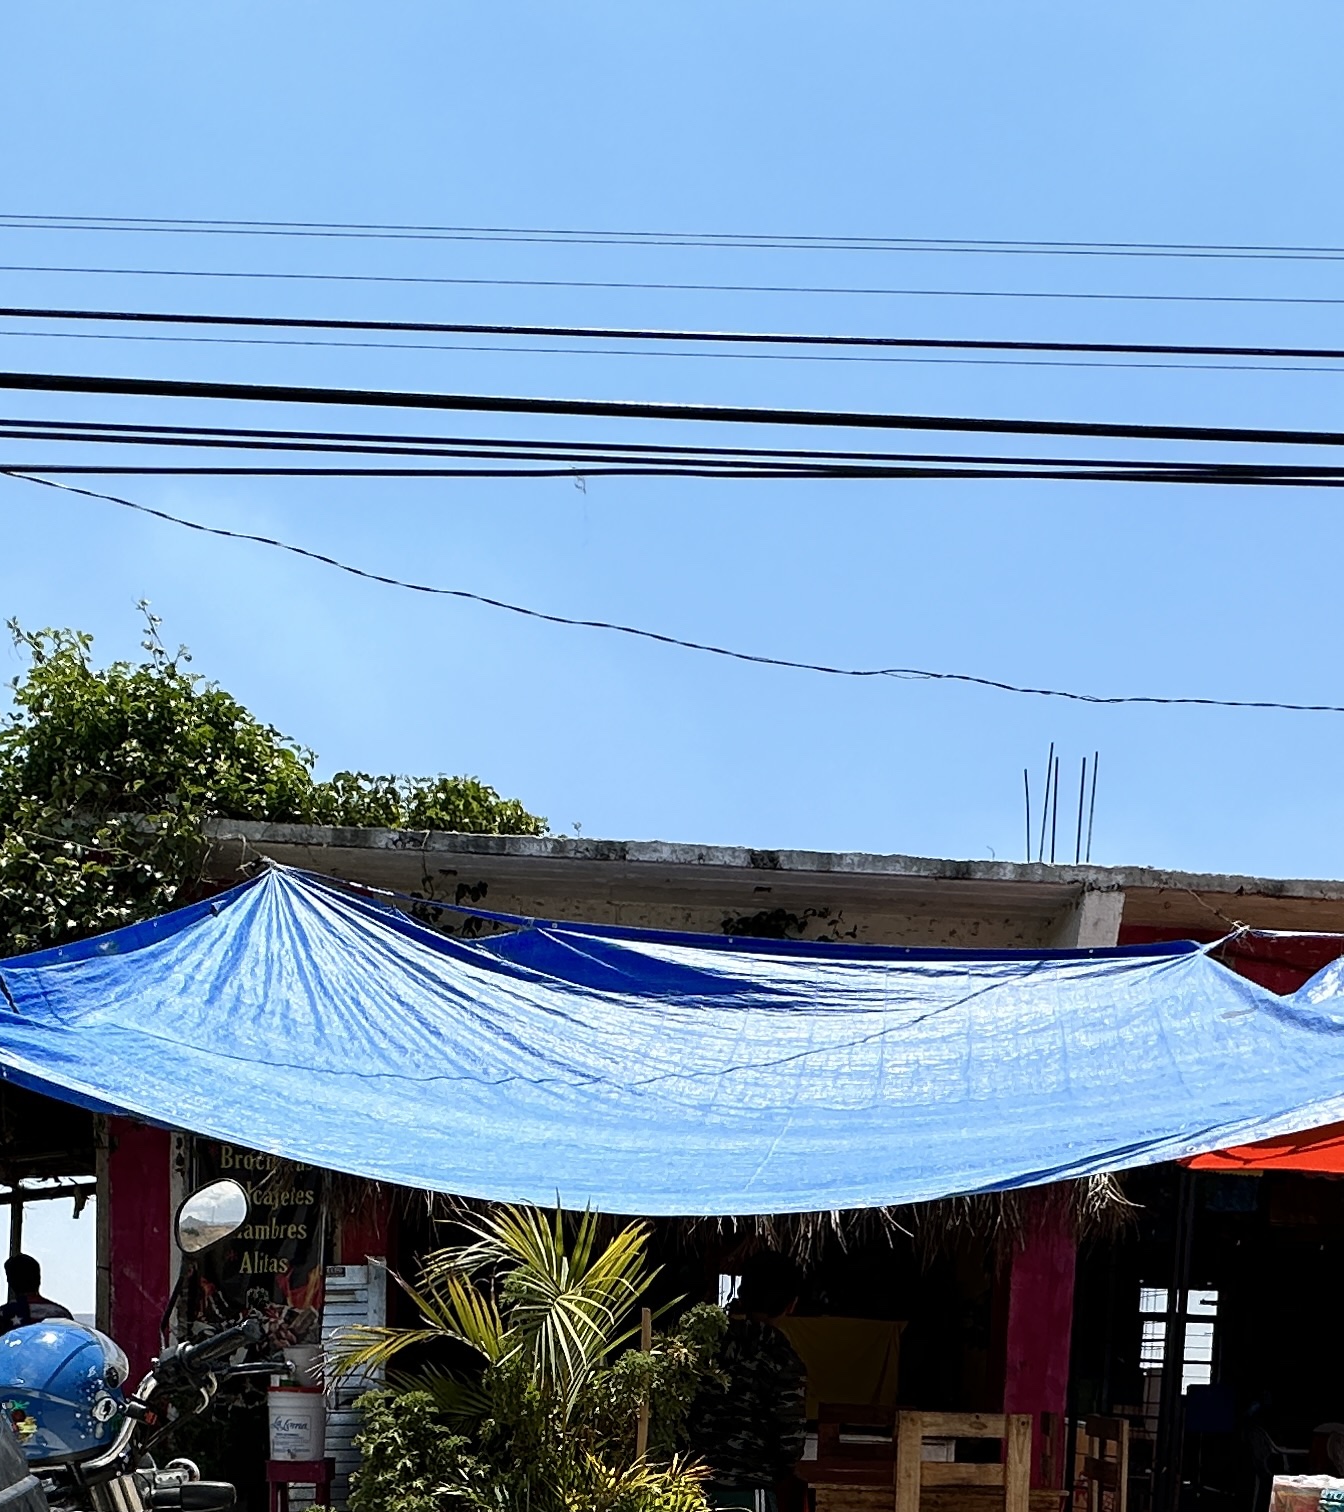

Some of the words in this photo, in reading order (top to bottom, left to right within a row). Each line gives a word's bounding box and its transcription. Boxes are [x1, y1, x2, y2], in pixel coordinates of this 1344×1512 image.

[246, 1181, 315, 1211] lcajetes
[234, 1217, 308, 1240] ambres
[239, 1251, 289, 1274] Alitas
